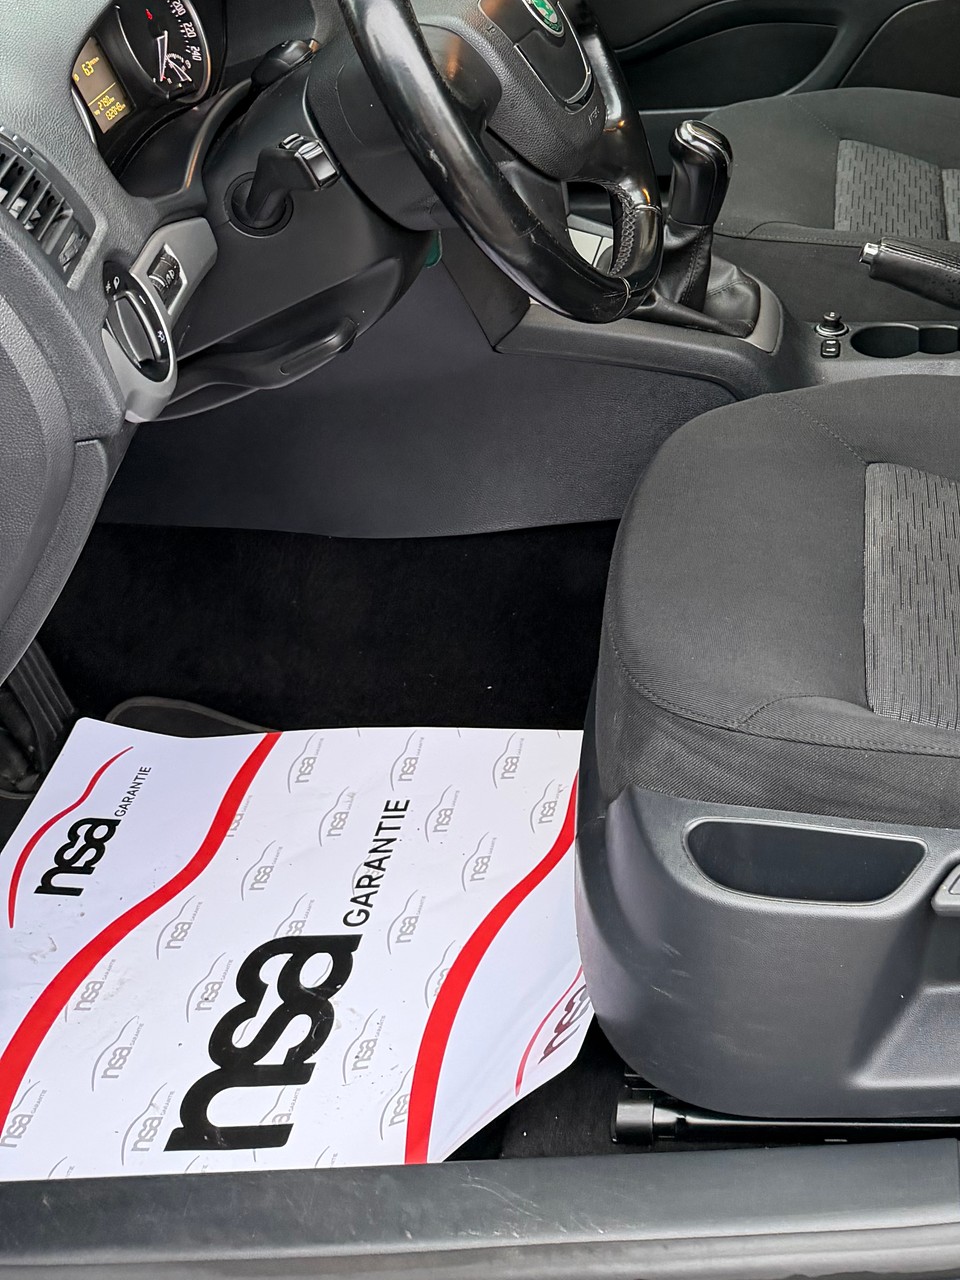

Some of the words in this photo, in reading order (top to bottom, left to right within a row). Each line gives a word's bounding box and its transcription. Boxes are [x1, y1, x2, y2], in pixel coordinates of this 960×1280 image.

[182, 21, 197, 38] 220
[191, 45, 202, 62] 240
[34, 817, 122, 896] nsa
[114, 766, 152, 817] GARANTIE
[163, 934, 363, 1152] nsa
[343, 800, 410, 927] GARANTIE
